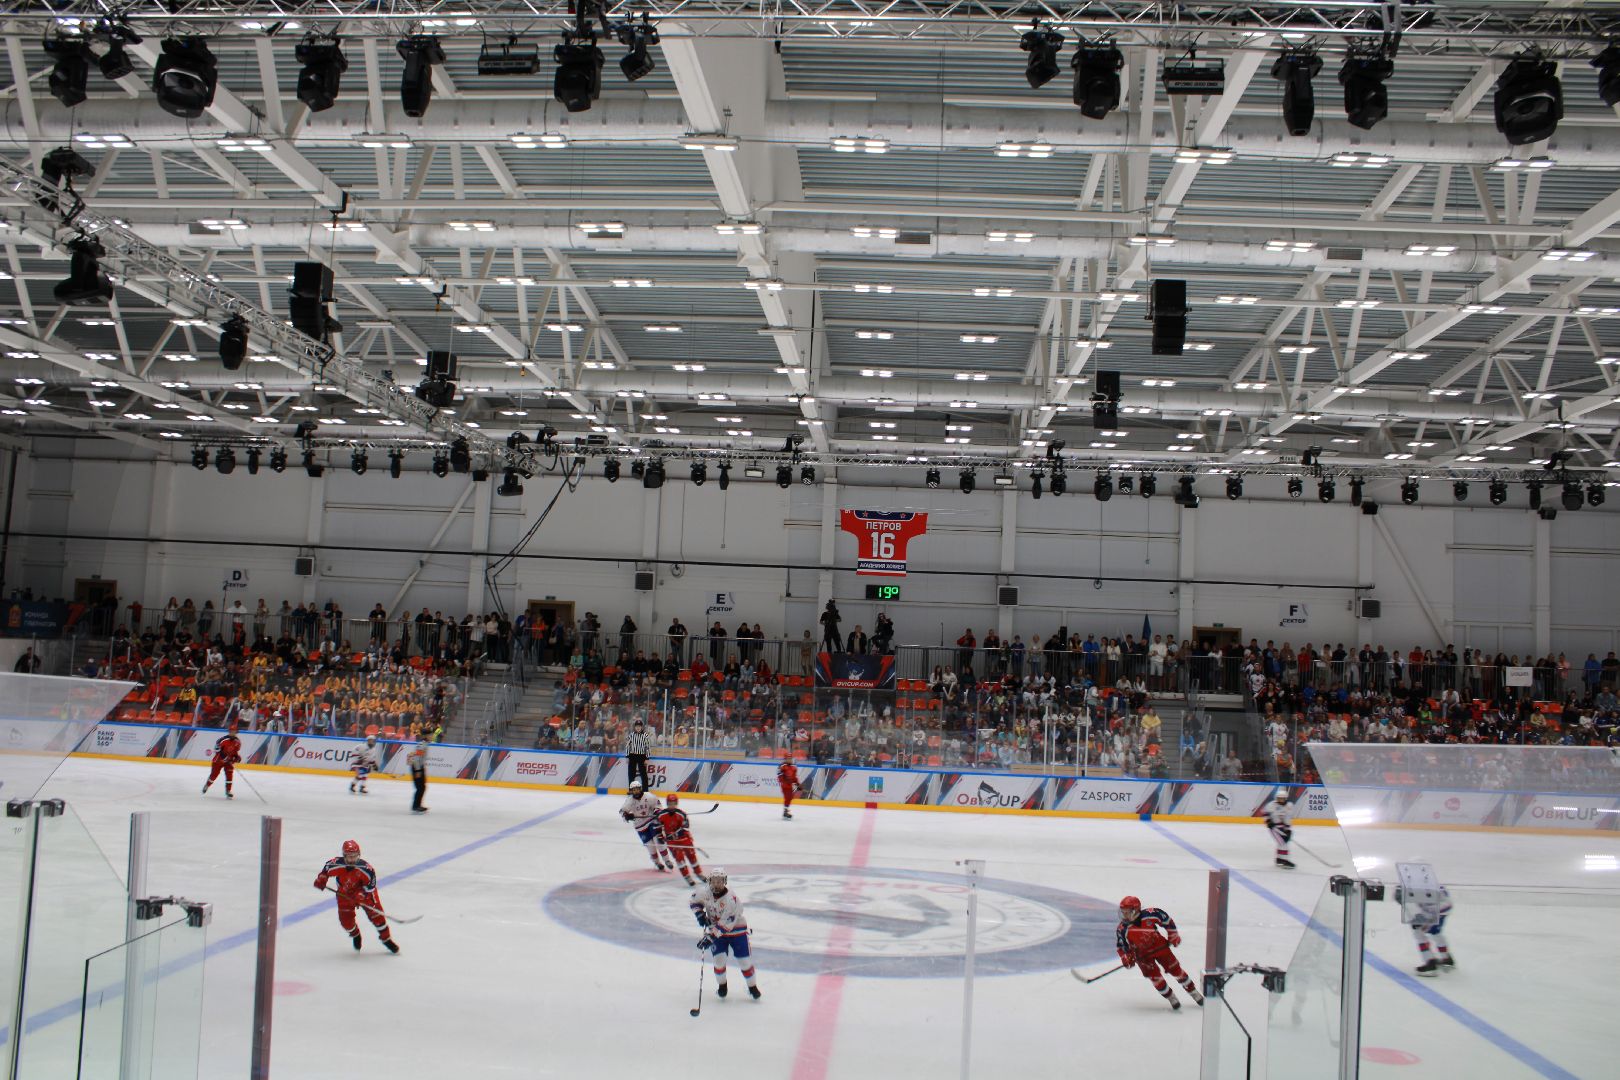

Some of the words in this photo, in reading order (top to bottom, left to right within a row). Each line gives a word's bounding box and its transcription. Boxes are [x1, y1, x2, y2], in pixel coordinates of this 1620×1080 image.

[866, 521, 902, 531] ПЕТРОВ
[871, 531, 896, 559] 16
[232, 570, 241, 581] D
[716, 593, 726, 605] E
[1290, 604, 1298, 616] F
[516, 768, 547, 777] СПОРТ
[1080, 790, 1133, 802] ZASPORT
